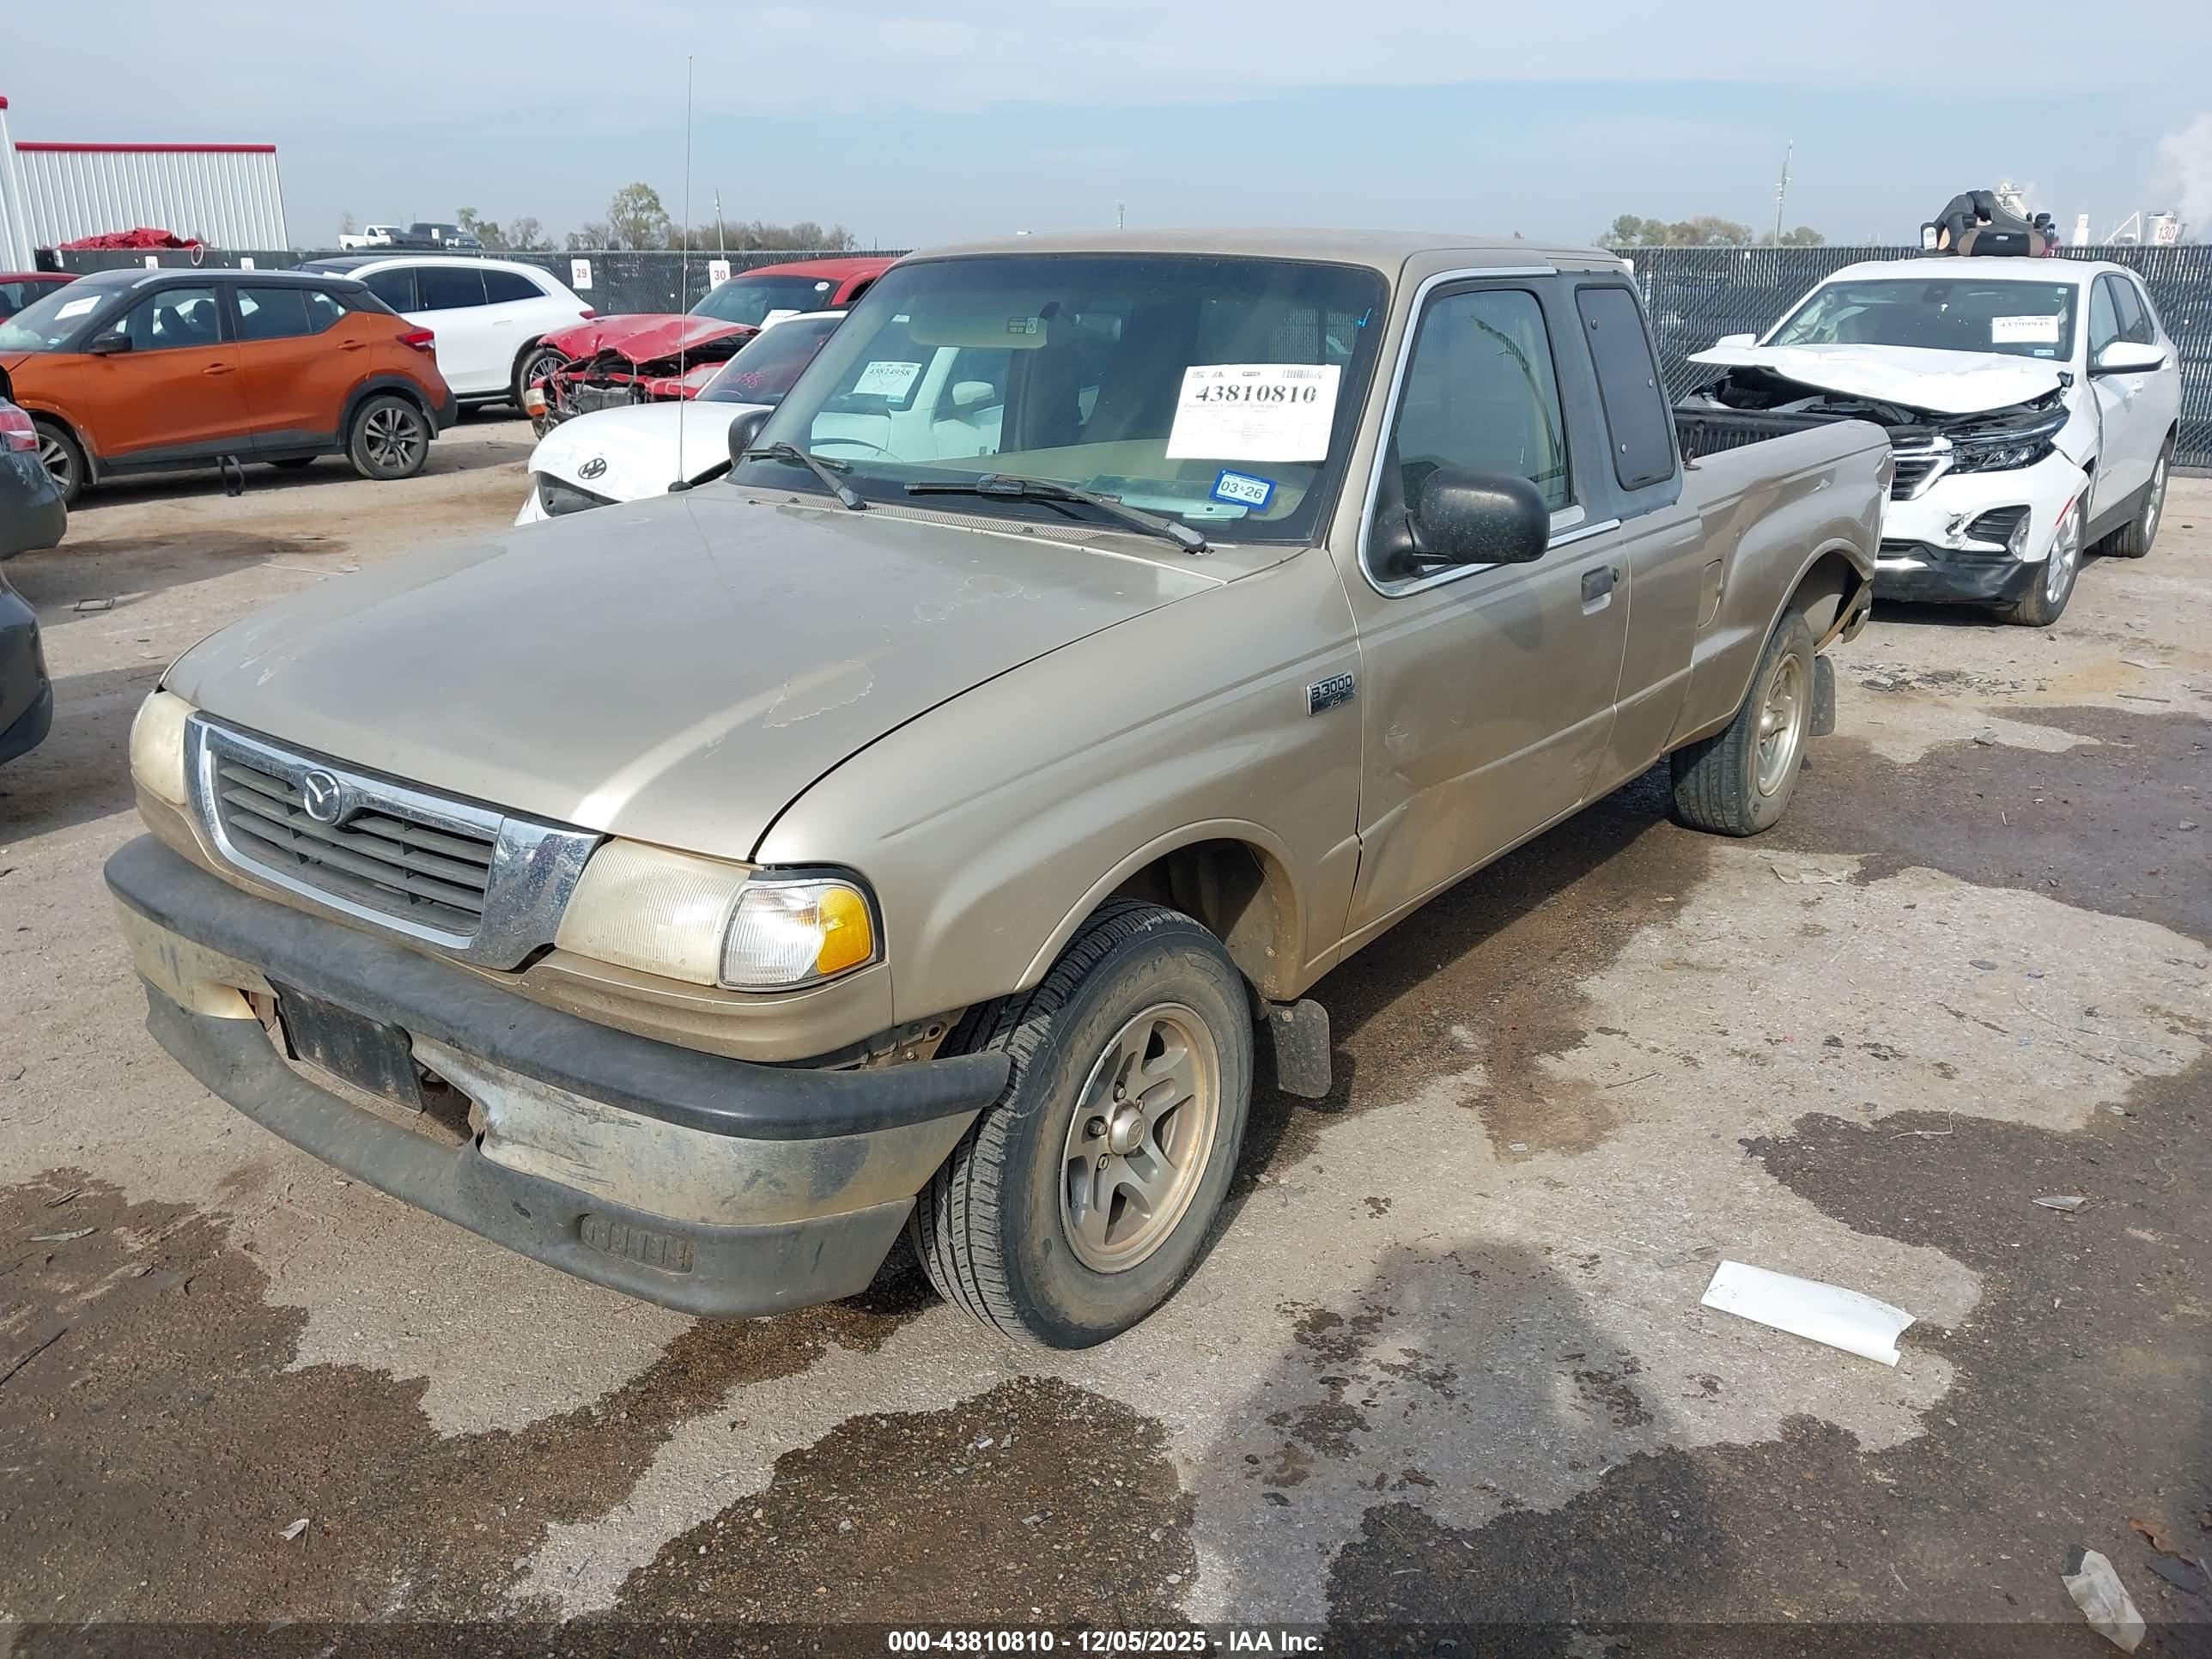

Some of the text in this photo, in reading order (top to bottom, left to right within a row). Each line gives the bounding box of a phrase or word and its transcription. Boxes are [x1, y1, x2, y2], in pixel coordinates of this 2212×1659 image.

[2157, 226, 2176, 240] 130
[575, 268, 587, 278] 29
[714, 270, 726, 281] 30
[1195, 383, 1318, 404] 43810810
[1311, 674, 1352, 700] B3000
